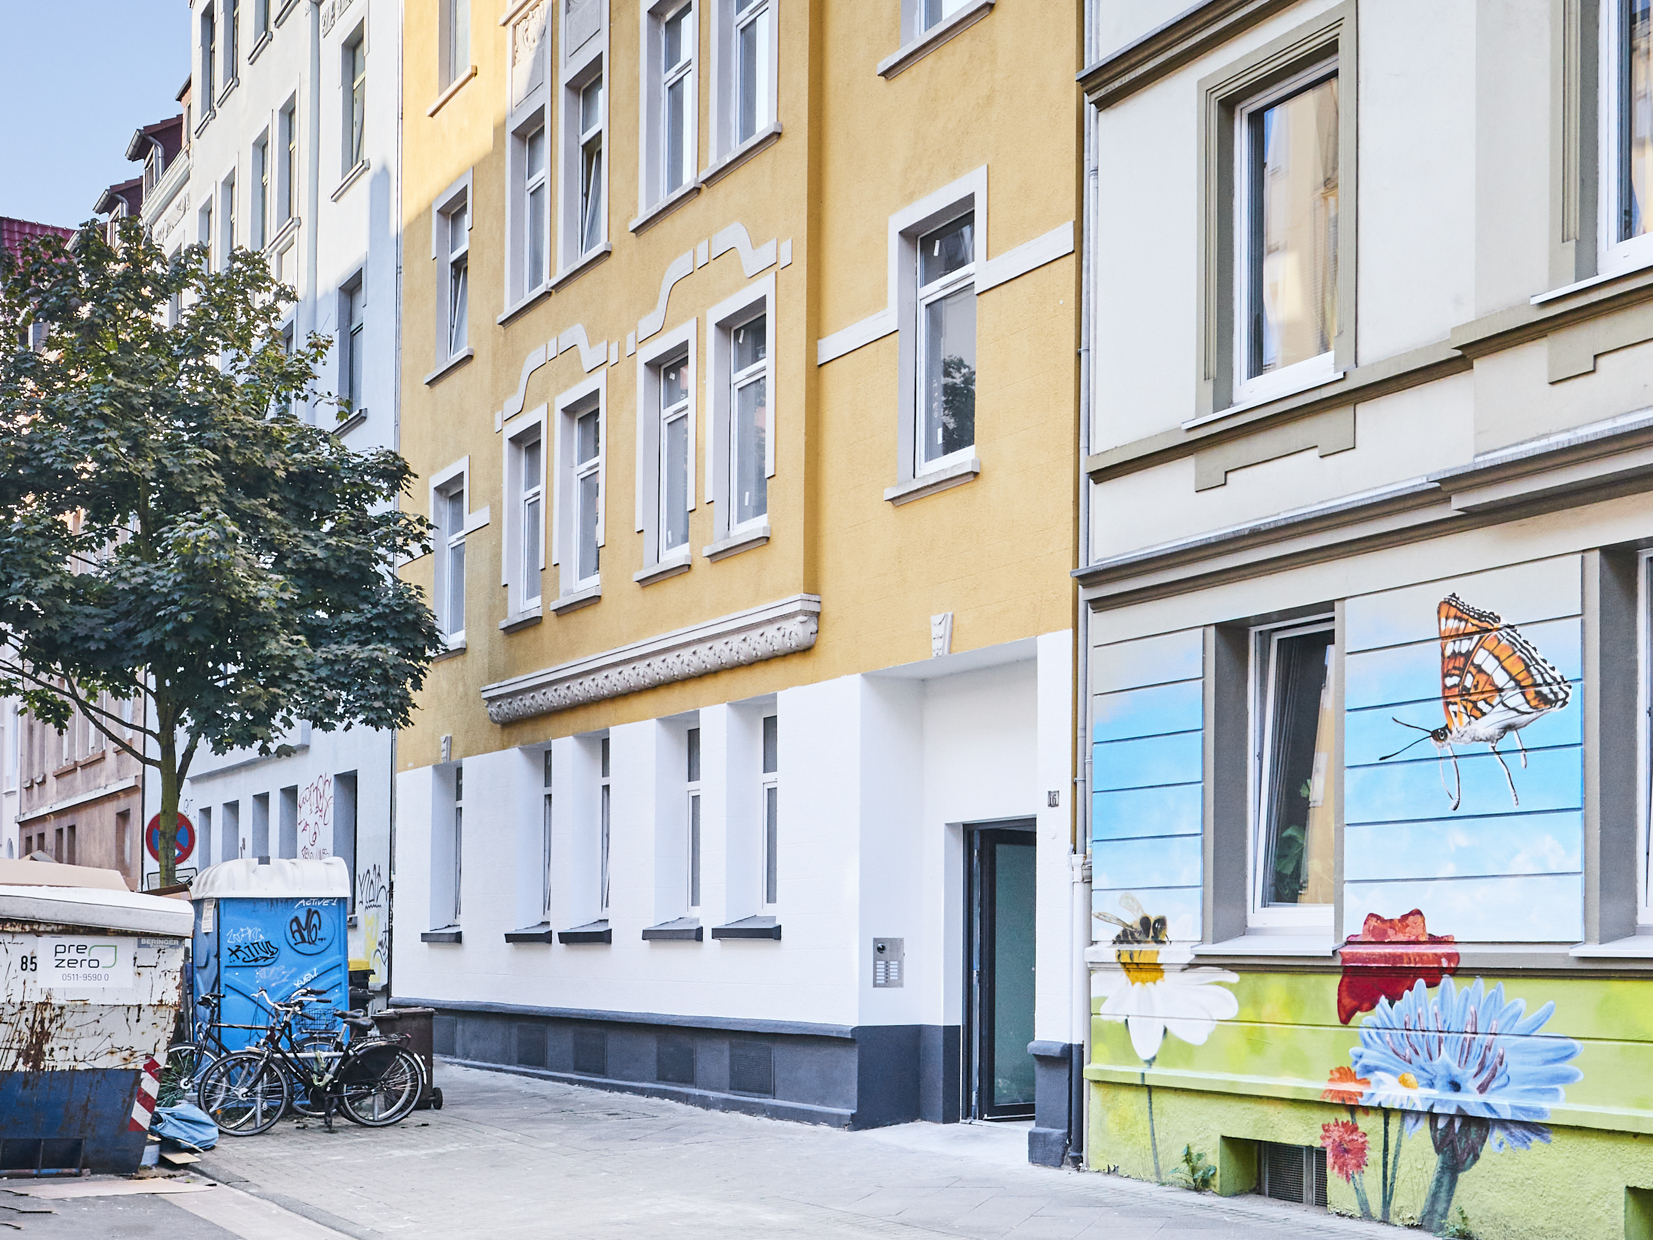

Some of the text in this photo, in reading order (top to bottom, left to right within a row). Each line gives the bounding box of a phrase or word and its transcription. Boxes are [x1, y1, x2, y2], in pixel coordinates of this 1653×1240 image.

[141, 938, 179, 946] BERINGER
[54, 944, 88, 957] pre
[20, 955, 37, 971] 85
[54, 958, 100, 968] zero
[61, 973, 110, 981] 0511-9590 0
